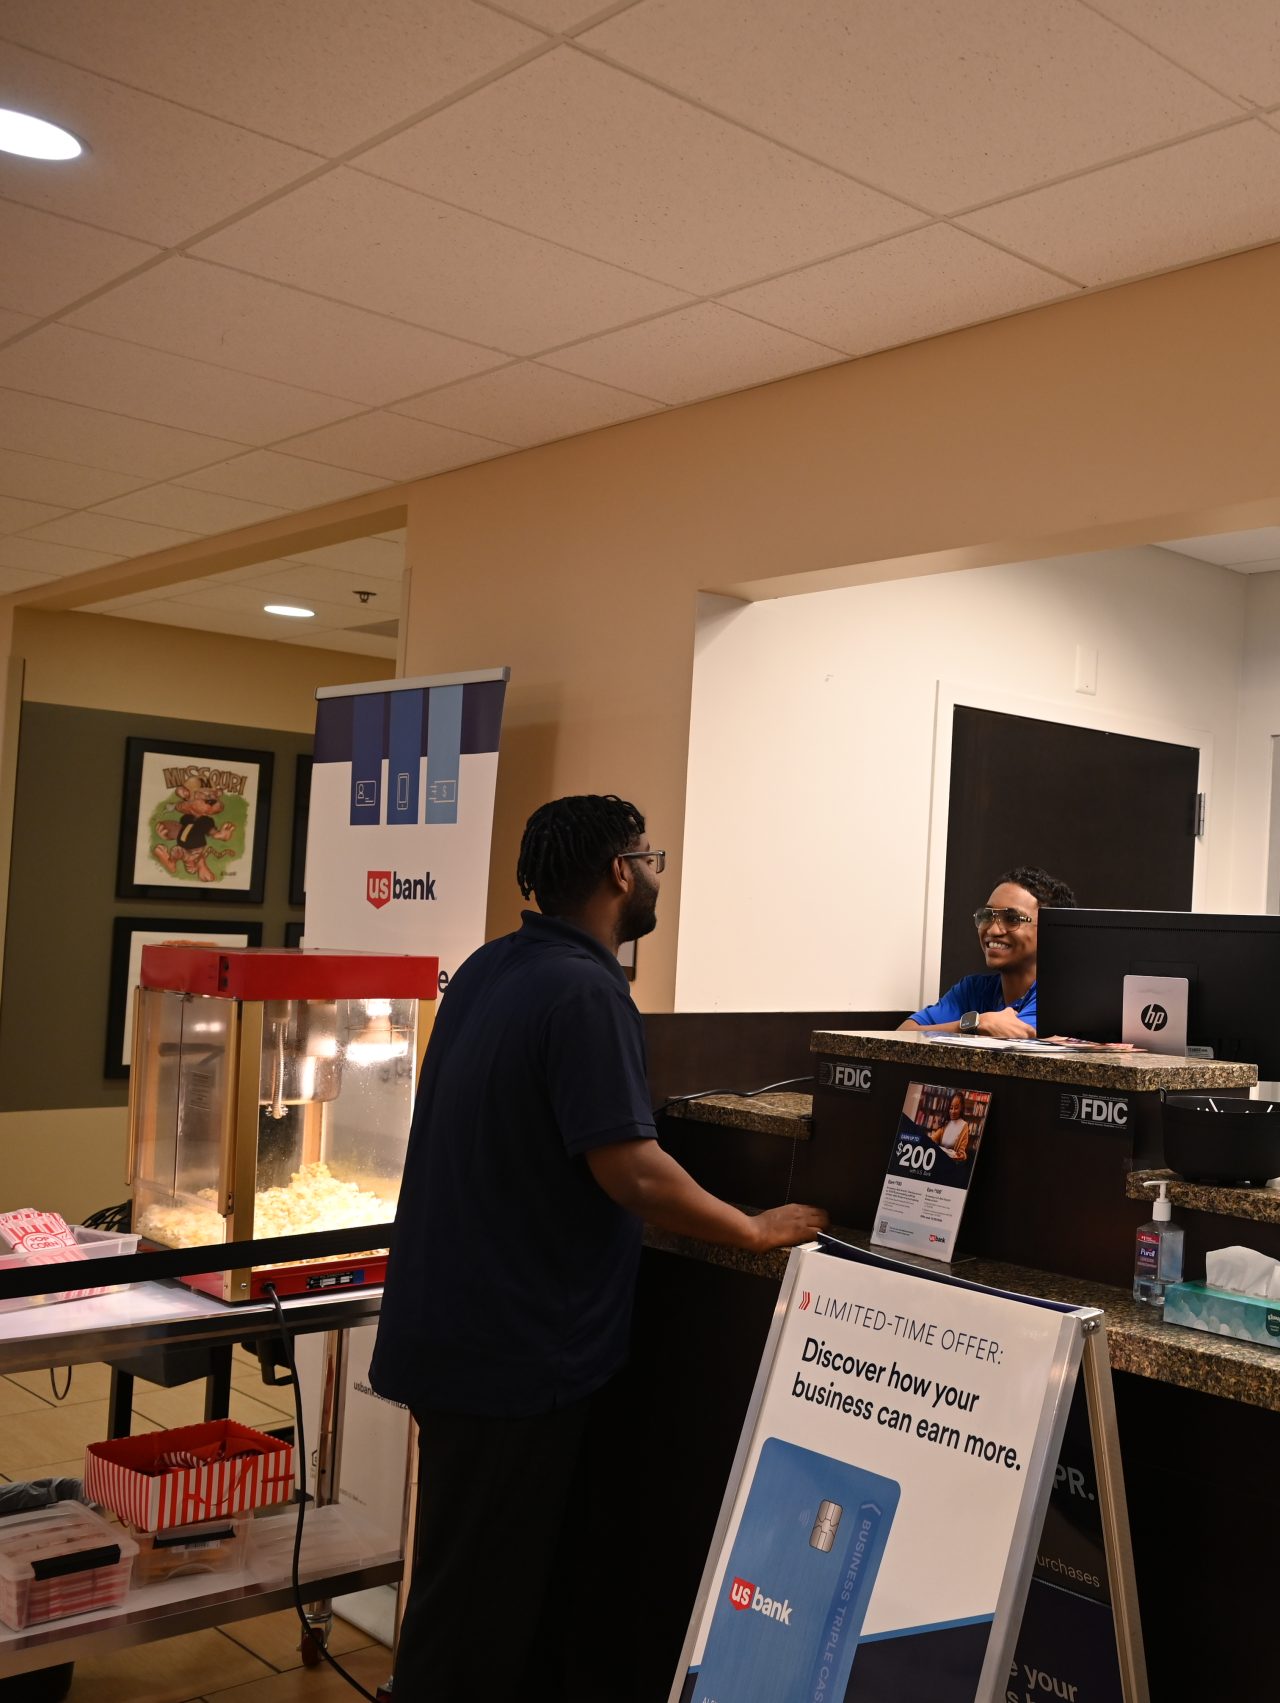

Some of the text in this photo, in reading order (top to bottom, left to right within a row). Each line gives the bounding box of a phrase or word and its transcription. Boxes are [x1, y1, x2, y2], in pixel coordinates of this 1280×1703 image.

[1144, 1004, 1165, 1031] hp
[835, 1066, 872, 1089] FDIC
[1081, 1098, 1129, 1125] FDIC
[896, 1141, 936, 1171] $200
[30, 1241, 59, 1250] CORN
[814, 1295, 1004, 1365] LIMITED-TIME OFFER:
[801, 1337, 980, 1413] Discover how your
[791, 1371, 1021, 1471] business can earn more.
[1053, 1463, 1095, 1501] PR.
[1036, 1555, 1101, 1588] urchases
[813, 1519, 872, 1703] BUSINESS TRIPLE CAS
[1024, 1664, 1078, 1703] your
